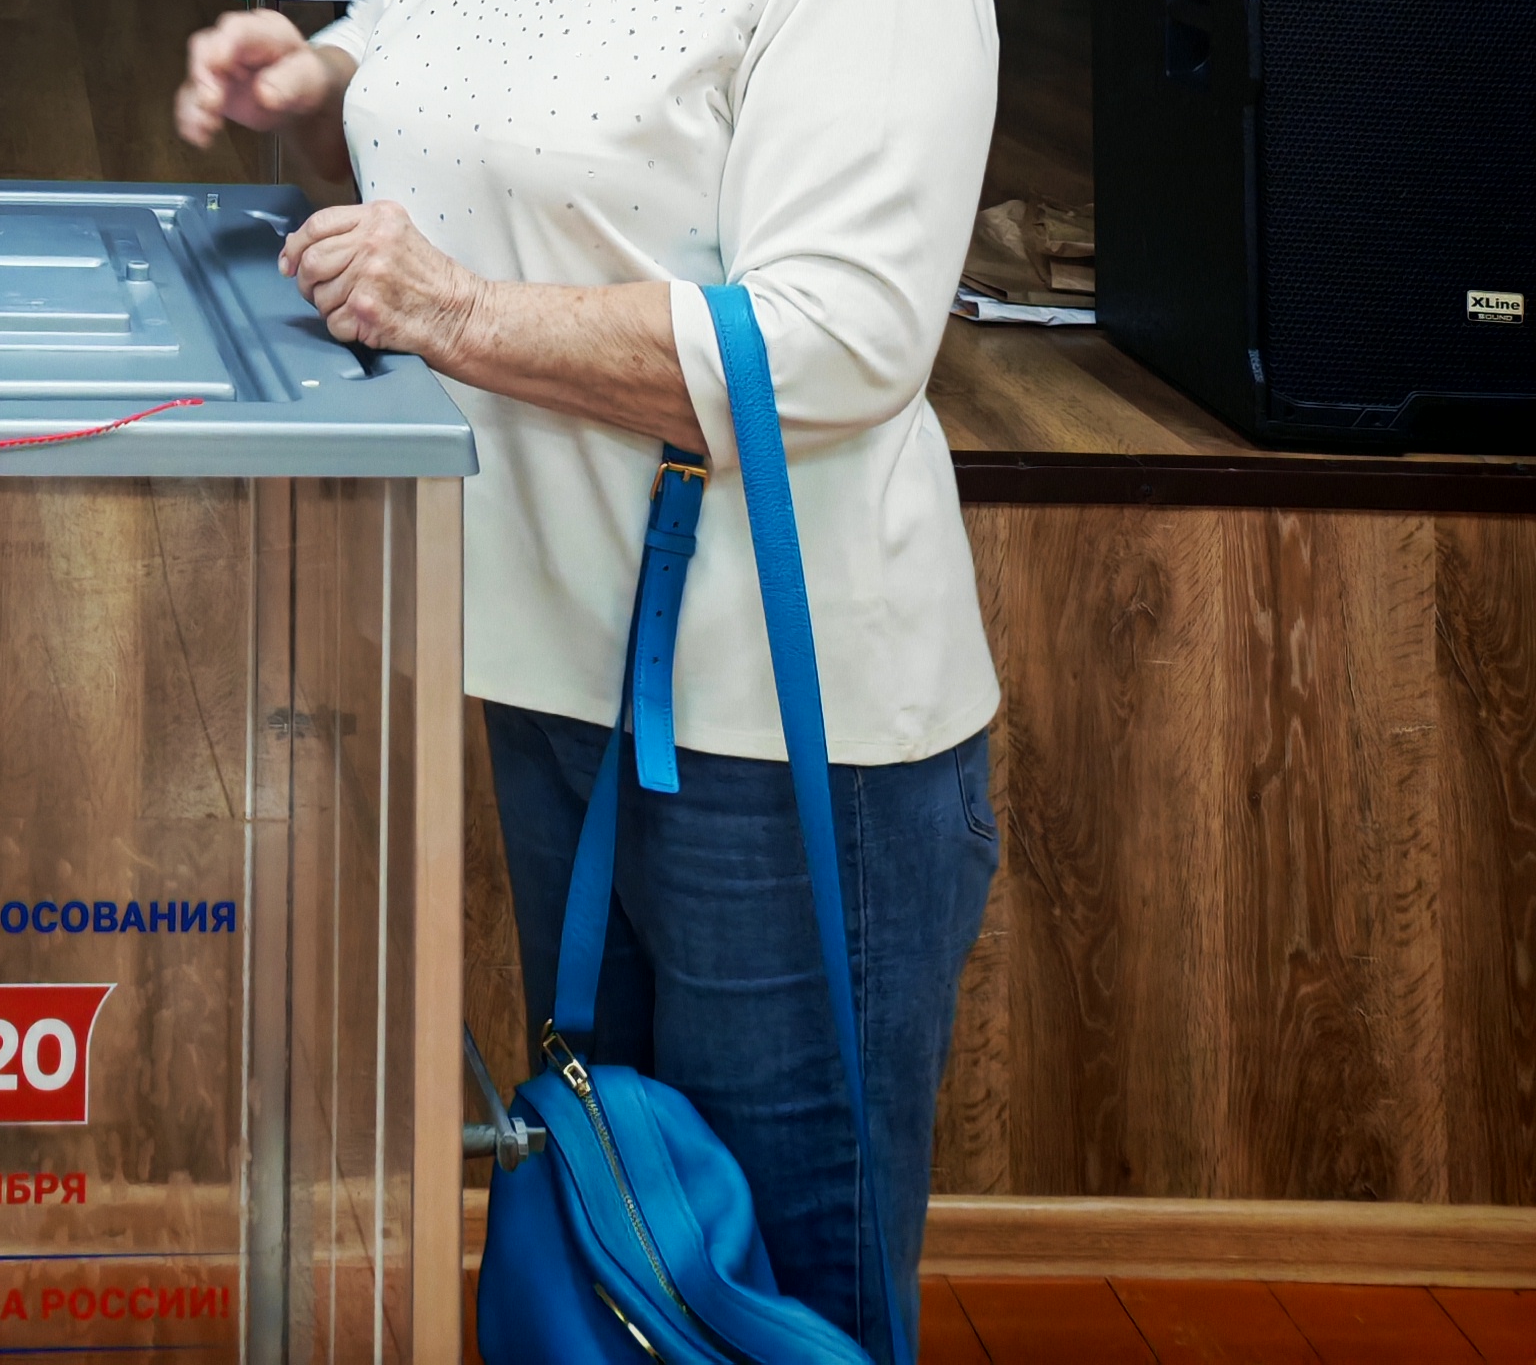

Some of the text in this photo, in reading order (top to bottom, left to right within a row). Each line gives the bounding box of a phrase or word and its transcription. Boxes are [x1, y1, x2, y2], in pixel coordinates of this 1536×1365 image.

[1471, 296, 1521, 310] XLine
[1478, 313, 1513, 321] SOUND
[40, 1286, 230, 1323] РОССИИ!
